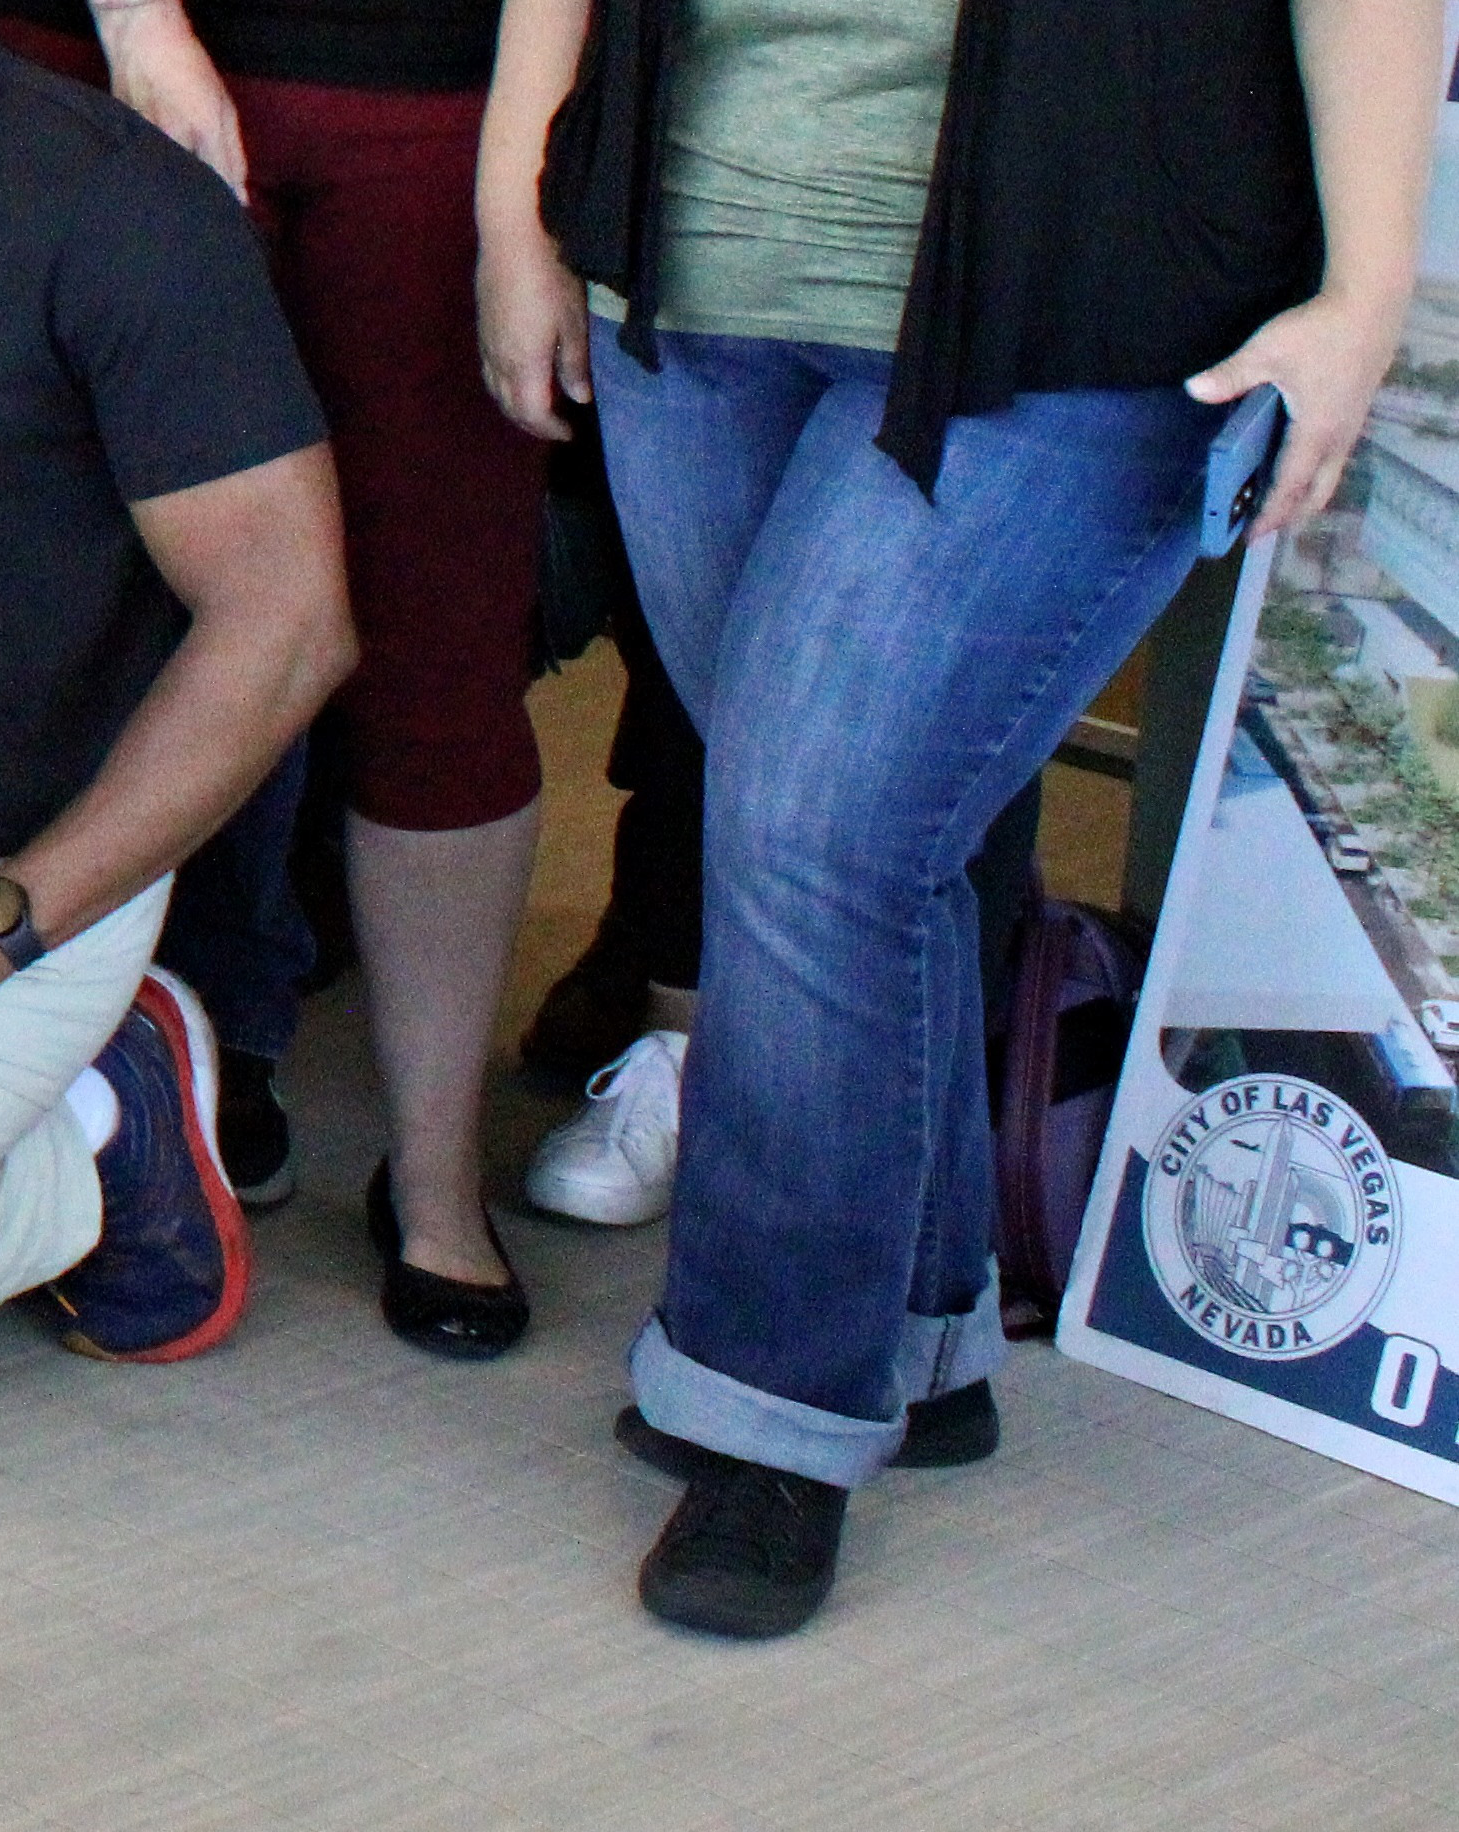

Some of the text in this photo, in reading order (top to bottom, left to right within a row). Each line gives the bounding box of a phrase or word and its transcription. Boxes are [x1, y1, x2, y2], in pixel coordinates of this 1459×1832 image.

[1161, 1086, 1390, 1247] CITY OF LAS VEGAS
[1180, 1284, 1313, 1349] NEVADA
